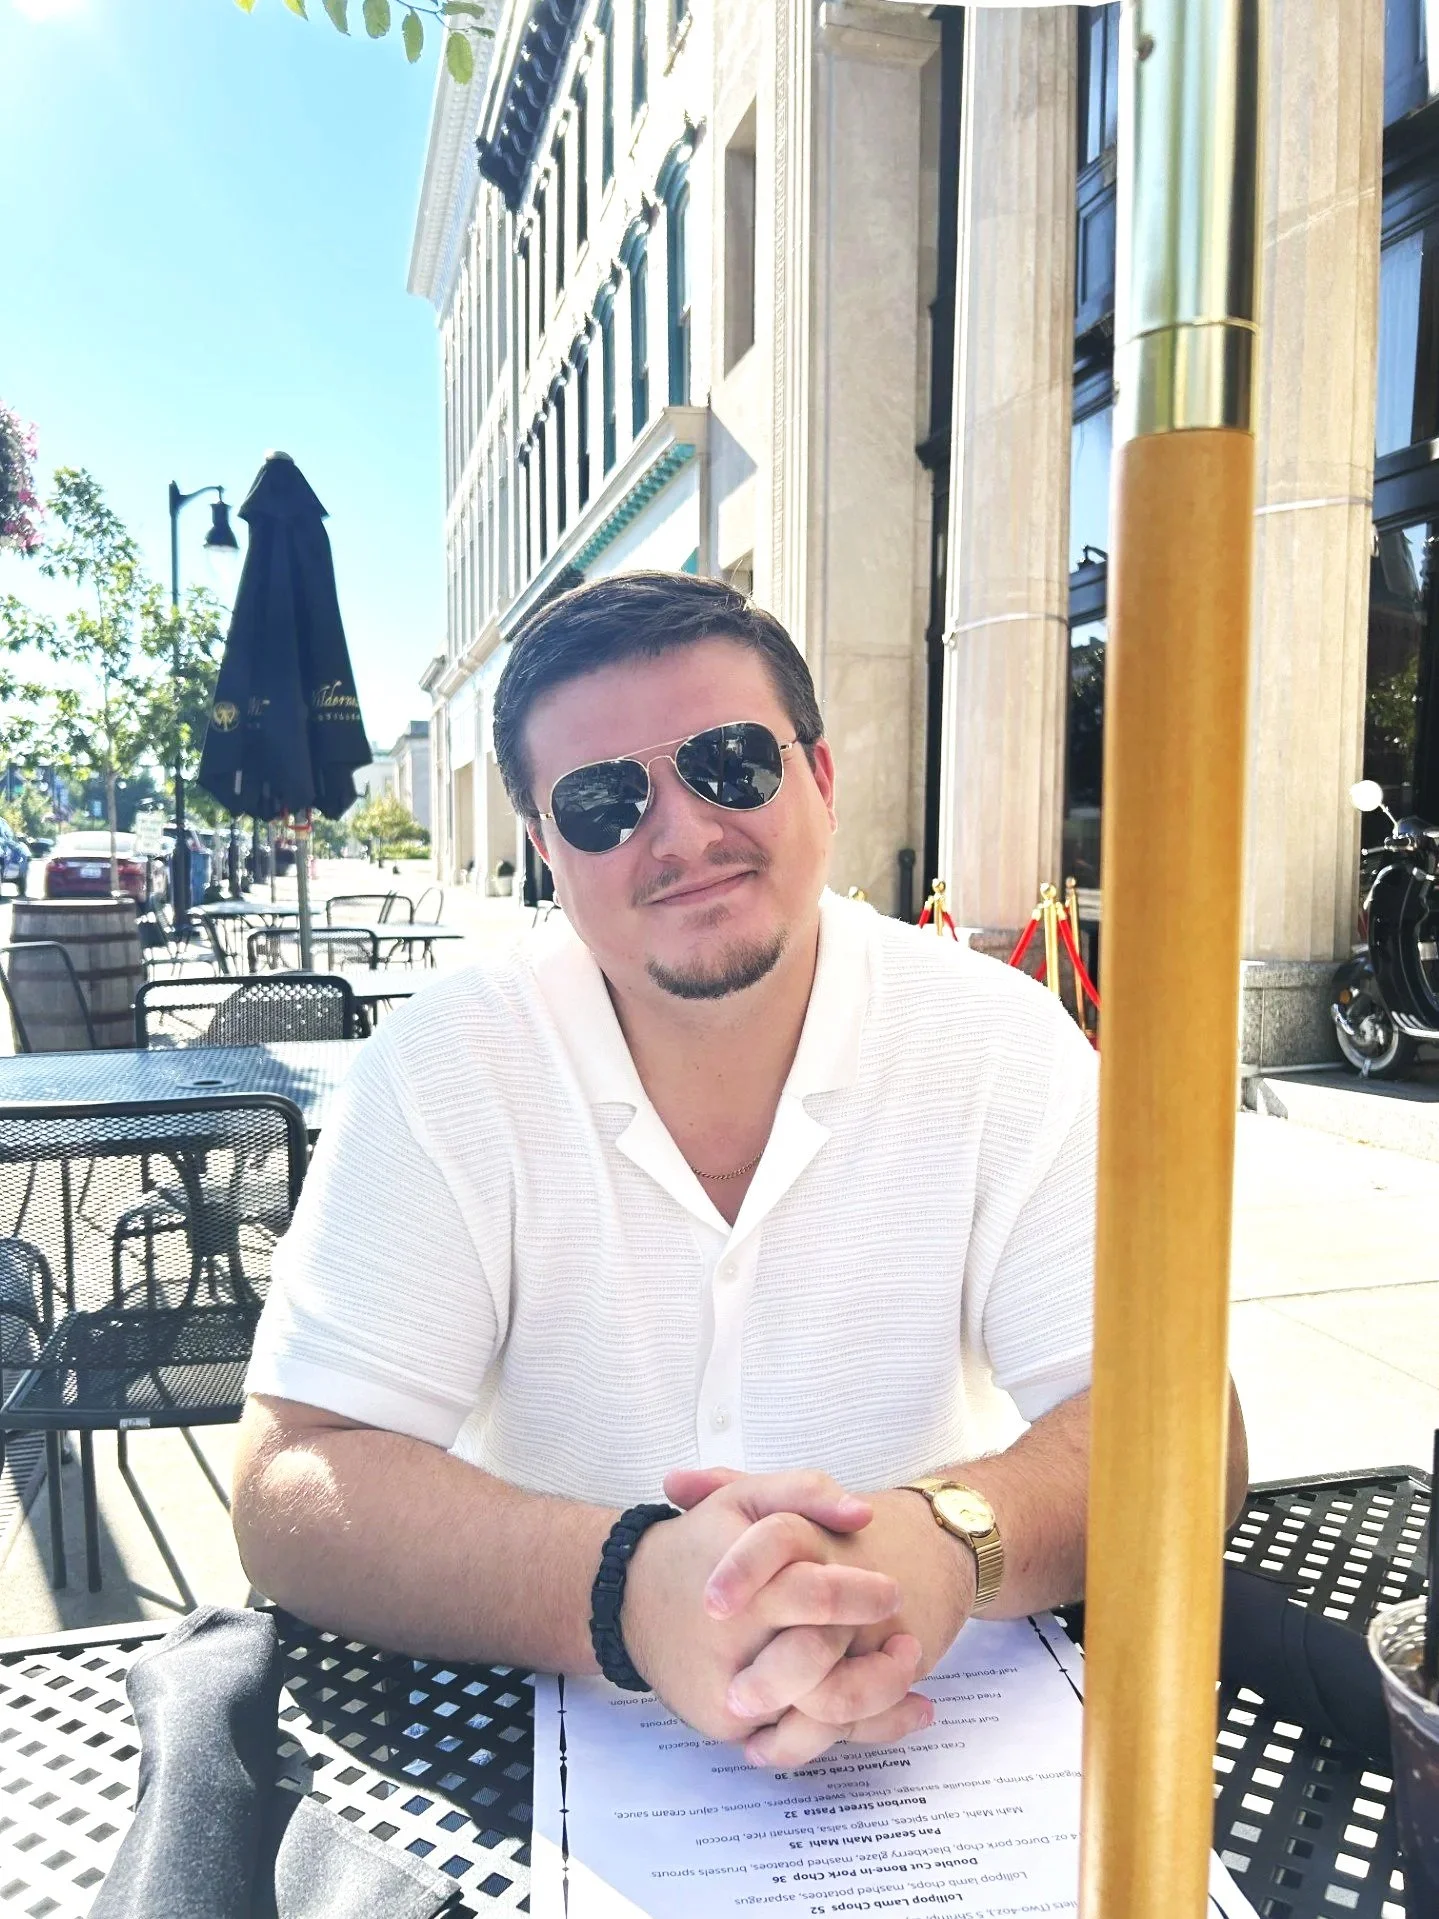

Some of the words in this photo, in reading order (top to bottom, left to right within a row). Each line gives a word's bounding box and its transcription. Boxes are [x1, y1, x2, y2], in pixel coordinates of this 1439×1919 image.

[938, 1694, 974, 1704] chicken
[977, 1692, 1002, 1700] Fried
[640, 1717, 678, 1728] sprouts
[938, 1717, 976, 1729] shrimp,
[978, 1716, 999, 1726] Gulf
[658, 1741, 699, 1751] focaccia
[907, 1743, 938, 1756] cakes,
[941, 1741, 965, 1752] Crab
[840, 1751, 861, 1763] rice,
[864, 1746, 906, 1760] basmati
[830, 1766, 855, 1777] Crab
[857, 1759, 910, 1773] Maryland
[775, 1772, 788, 1780] 30
[793, 1768, 826, 1779] Cakes
[1036, 1769, 1081, 1780] Rigatoni,
[827, 1780, 870, 1791] focaccia
[943, 1779, 991, 1792] andouille
[993, 1776, 1033, 1786] shrimp,
[848, 1789, 891, 1800] chicken,
[893, 1783, 939, 1796] sausage,
[764, 1795, 812, 1808] peppers,
[815, 1794, 845, 1803] sweet
[877, 1796, 926, 1808] Bourbon
[689, 1806, 718, 1816] cajun
[722, 1802, 761, 1814] onions,
[804, 1807, 835, 1817] Pasta
[839, 1802, 874, 1813] Street
[995, 1805, 1023, 1815] Mahi
[614, 1810, 649, 1821] sauce,
[652, 1809, 686, 1819] cream
[784, 1810, 798, 1819] 32
[931, 1811, 960, 1823] cajun
[962, 1809, 993, 1819] Mahi,
[850, 1820, 889, 1832] mango
[892, 1814, 928, 1828] spices,
[769, 1827, 814, 1839] basmati
[817, 1823, 848, 1833] salsa,
[918, 1827, 941, 1837] Pan
[695, 1835, 740, 1847] broccoli
[743, 1831, 766, 1842] rice,
[842, 1835, 872, 1846] Mahi
[875, 1831, 916, 1842] Seared
[1015, 1836, 1050, 1846] Duroc
[789, 1841, 803, 1849] 35
[809, 1838, 839, 1848] Mahi
[953, 1842, 984, 1854] chop,
[988, 1839, 1012, 1849] pork
[855, 1851, 887, 1864] glaze,
[890, 1845, 951, 1859] blackberry
[750, 1859, 804, 1872] potatoes,
[808, 1856, 853, 1869] mashed
[910, 1862, 932, 1871] Cut
[935, 1857, 978, 1869] Double
[651, 1868, 695, 1879] sprouts
[698, 1865, 747, 1877] brussels
[827, 1870, 856, 1880] Pork
[860, 1865, 907, 1876] Bone-In
[772, 1875, 787, 1883] 36
[793, 1871, 824, 1883] Chop
[948, 1877, 978, 1888] lamb
[980, 1871, 1028, 1885] Lollipop
[857, 1885, 904, 1896] mashed
[907, 1879, 946, 1891] chops,
[734, 1893, 796, 1906] asparagus
[798, 1887, 854, 1901] potatoes,
[912, 1893, 963, 1904] Lollipop
[831, 1900, 870, 1912] Chops
[874, 1898, 909, 1909] Lamb
[1052, 1901, 1078, 1909] ilets
[810, 1905, 825, 1915] 52
